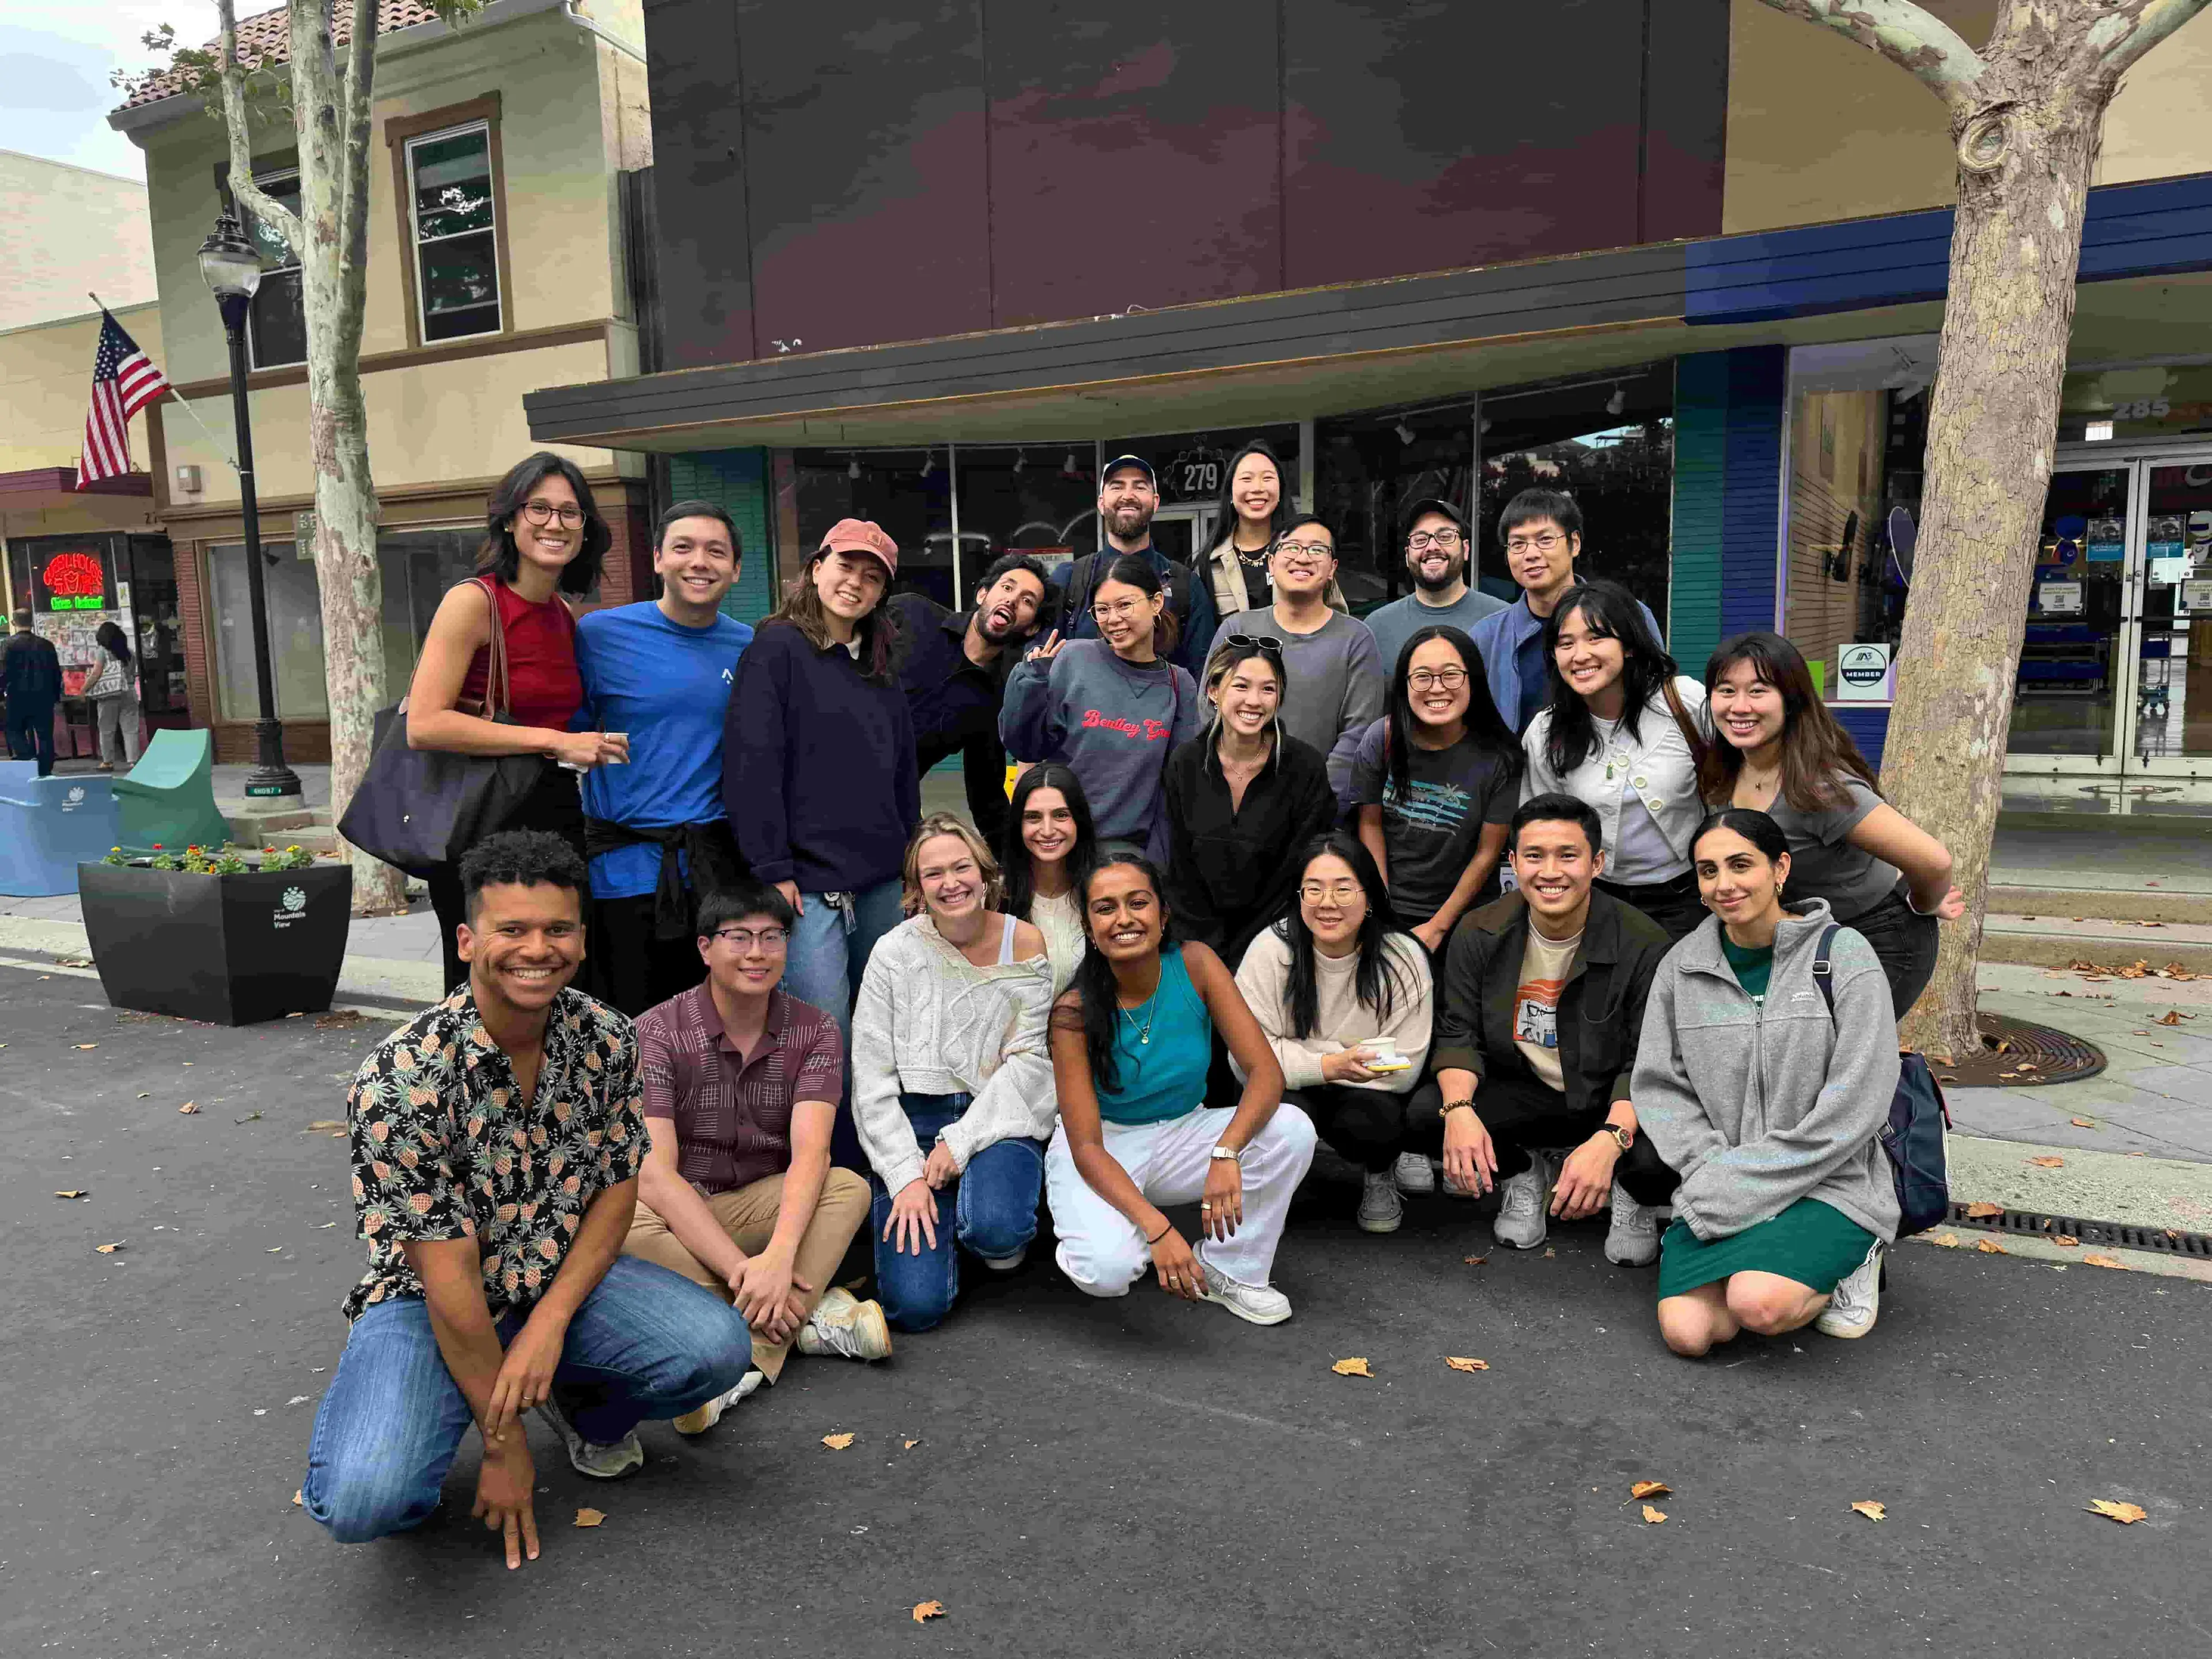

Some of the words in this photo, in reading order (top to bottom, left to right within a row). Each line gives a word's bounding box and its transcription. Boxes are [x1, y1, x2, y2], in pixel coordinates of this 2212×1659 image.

[2112, 397, 2169, 419] 285
[1184, 463, 1217, 491] 279
[1082, 709, 1141, 738] Bentley
